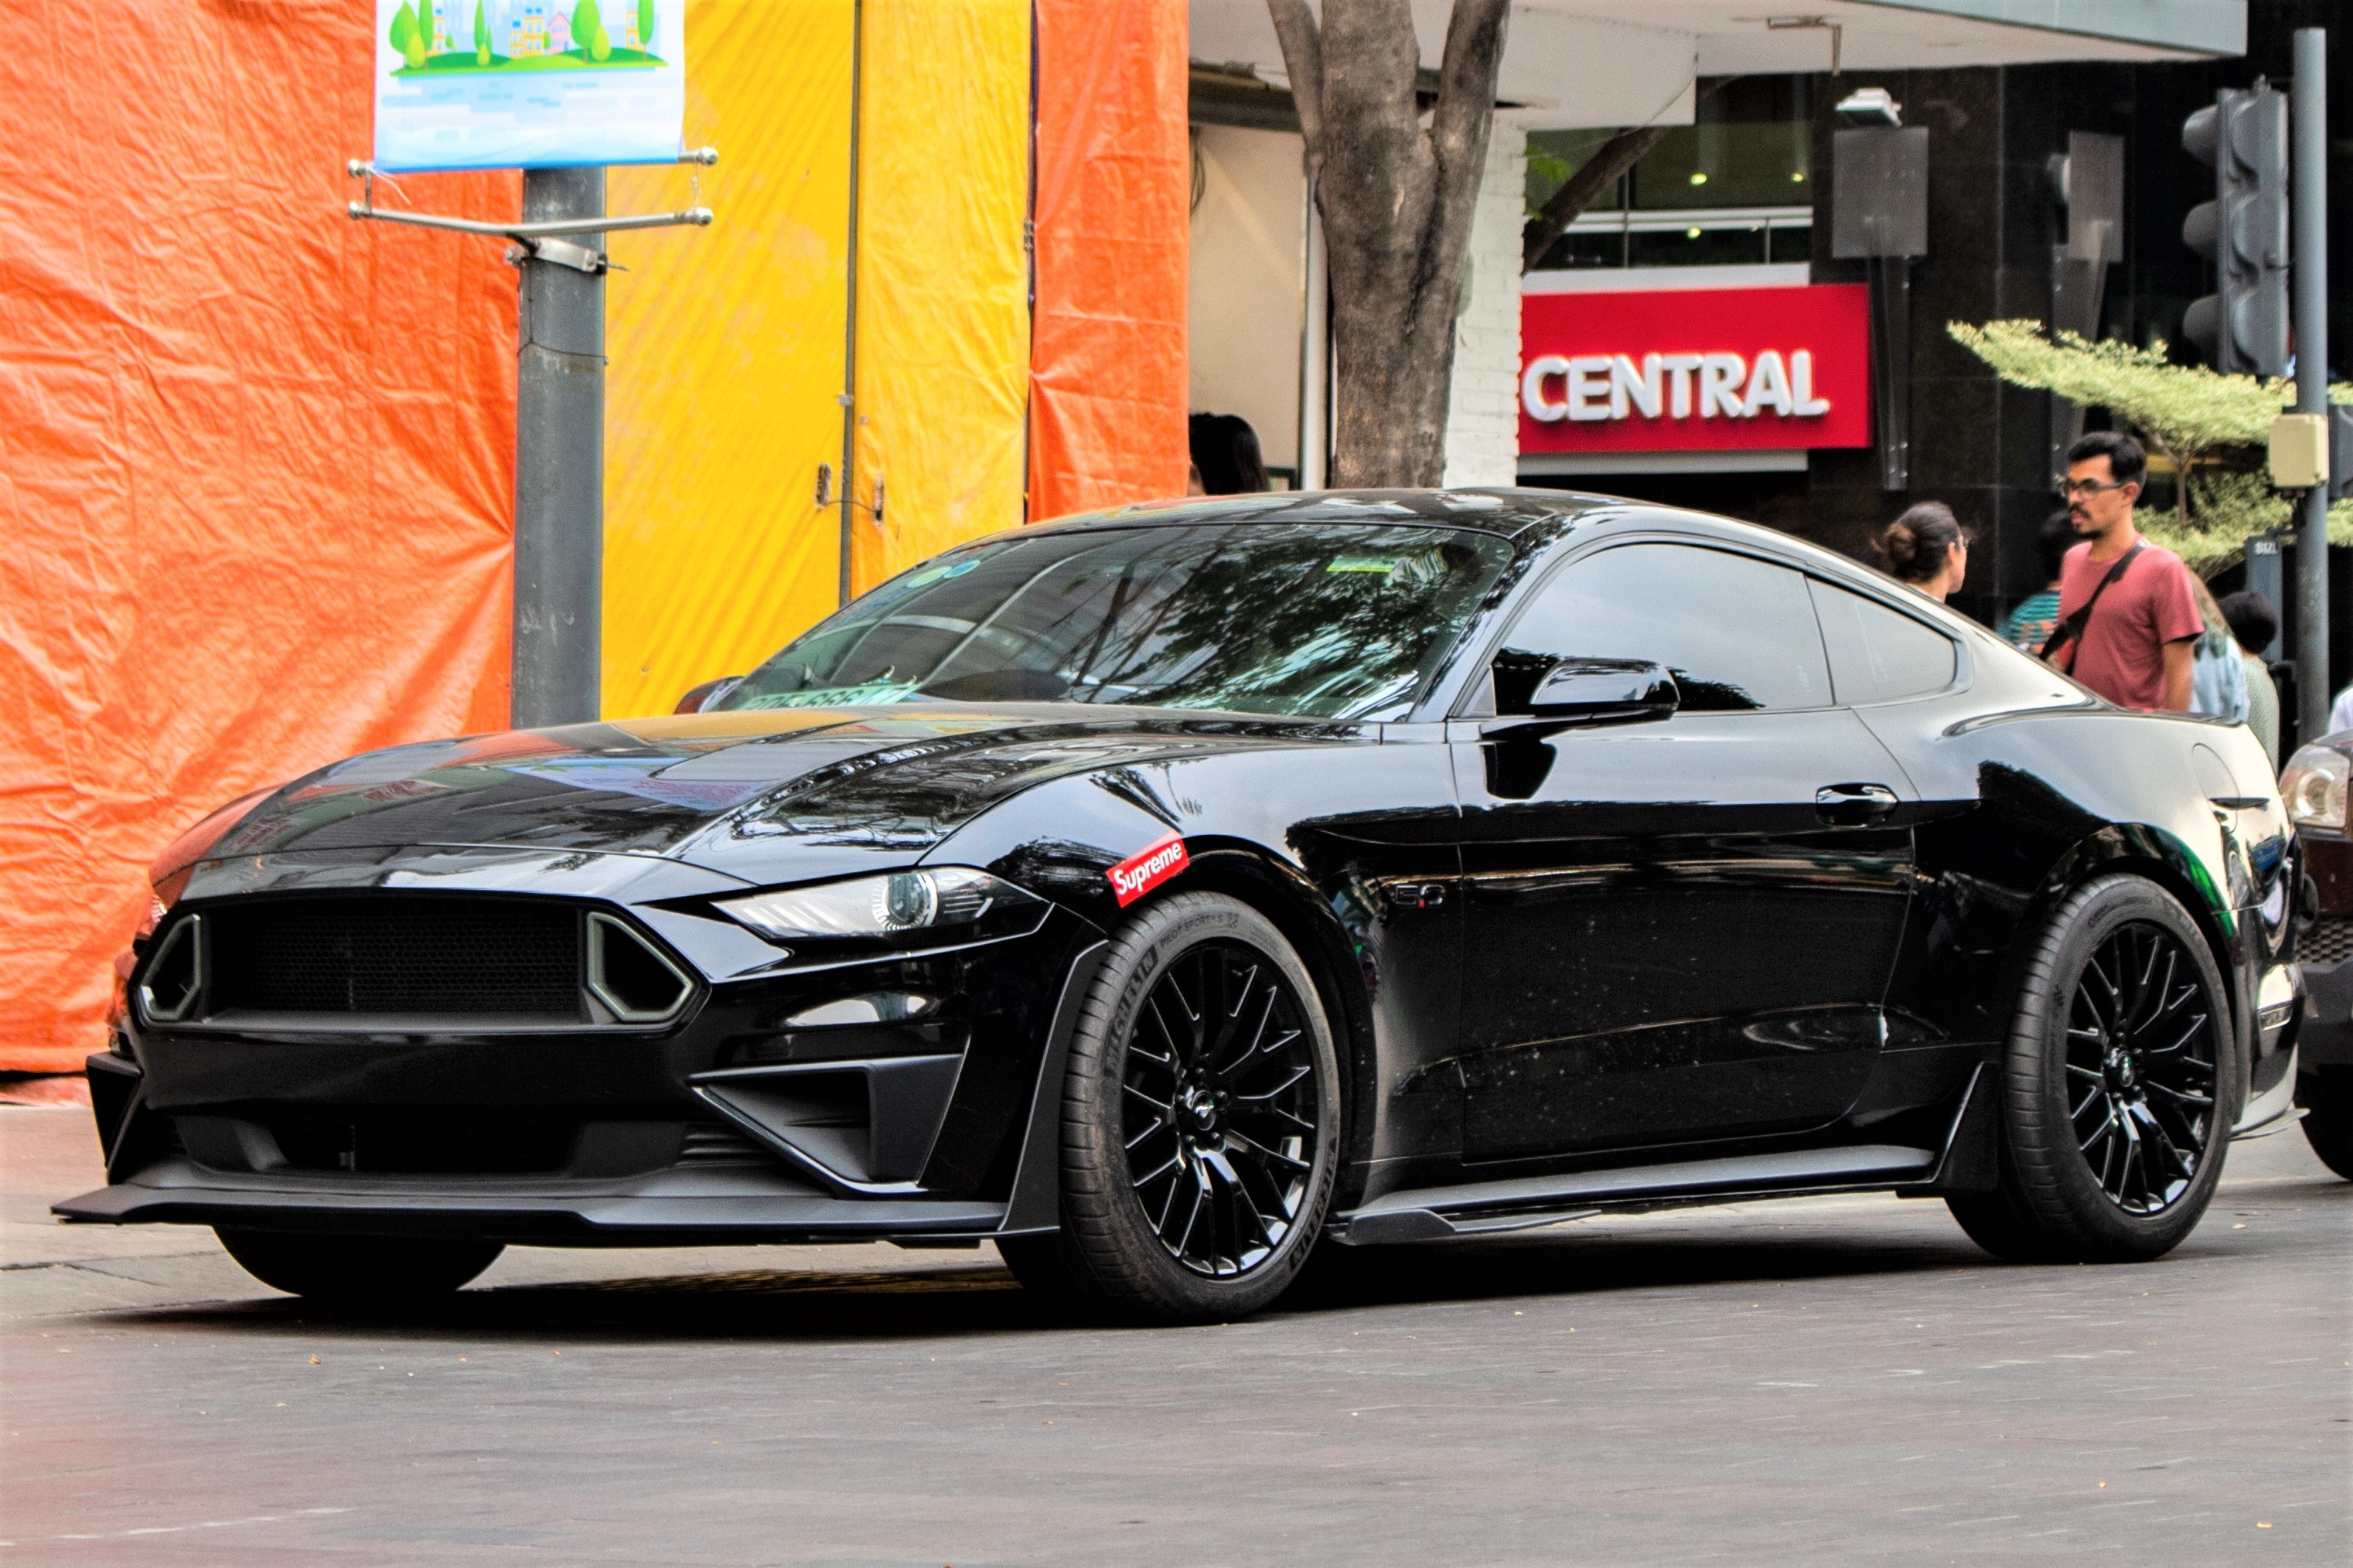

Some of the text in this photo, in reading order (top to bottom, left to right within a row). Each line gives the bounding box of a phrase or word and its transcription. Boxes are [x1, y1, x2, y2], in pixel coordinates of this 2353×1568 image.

[1523, 350, 1830, 422] CENTRAL
[1114, 843, 1182, 895] Supreme
[1395, 885, 1447, 908] 5.0
[1103, 946, 1157, 1076] MICHELIN
